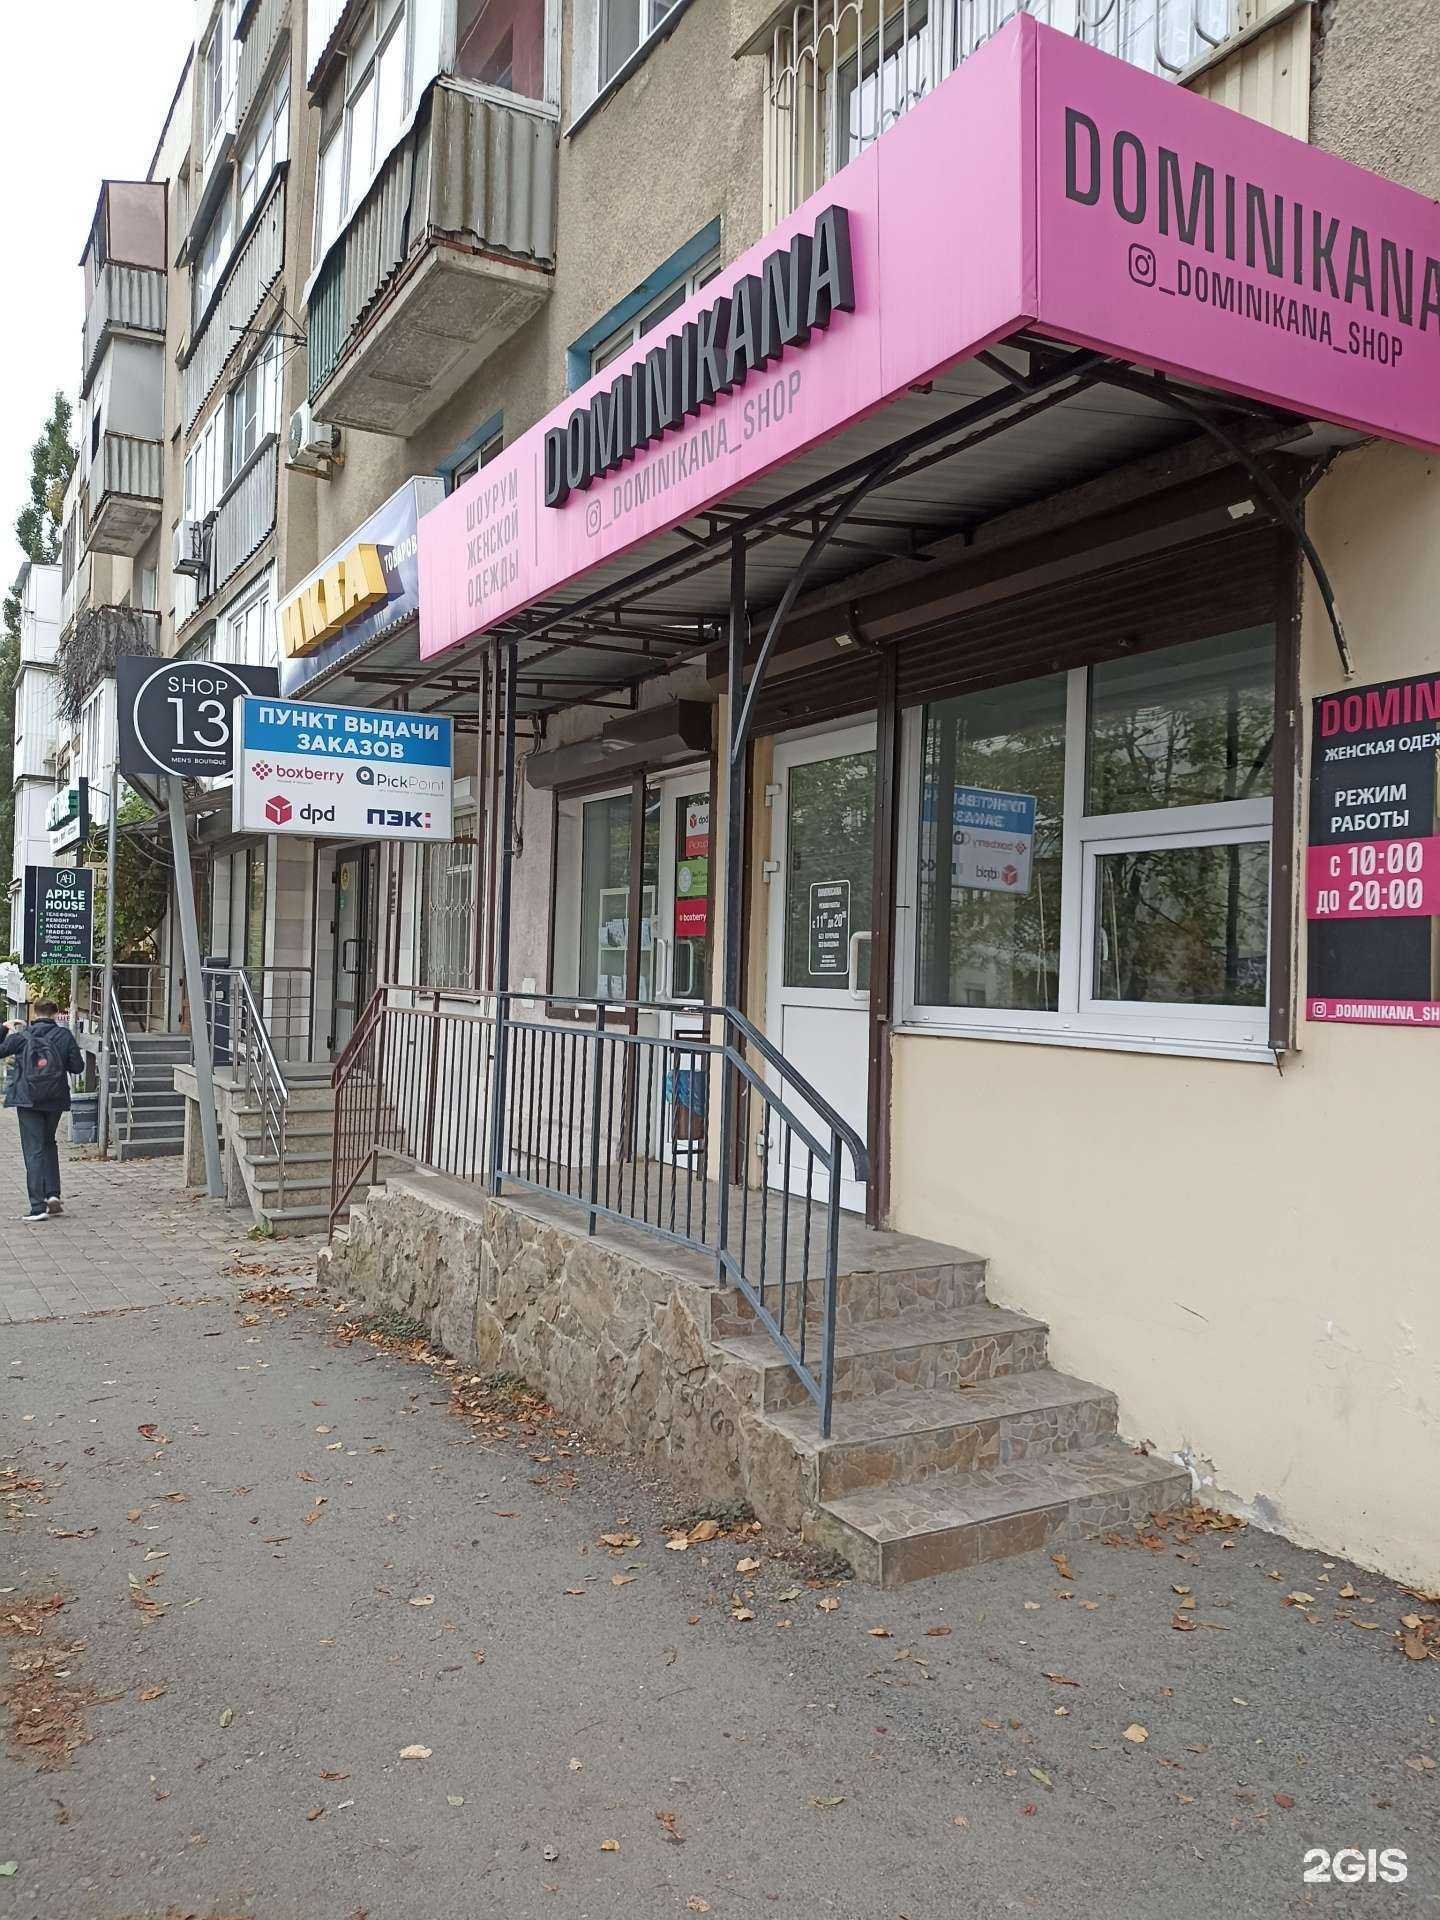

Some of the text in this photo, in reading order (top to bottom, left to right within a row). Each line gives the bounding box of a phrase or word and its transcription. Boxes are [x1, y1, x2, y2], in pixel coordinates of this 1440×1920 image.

[1065, 106, 1440, 332] DOMINIKANA
[1159, 259, 1403, 367] _DOMINIKANA_SHOP
[544, 203, 855, 508] DOMINIKANA
[602, 370, 802, 529] _DOMINIKANA_SHOP
[466, 468, 518, 532] ШОУРУМ
[467, 503, 519, 570] ЖЕНСКОЙ
[468, 550, 519, 608] ОДЕЖДЫ
[167, 676, 228, 696] SHOP
[1321, 678, 1440, 737] DOMIN
[167, 697, 230, 748] 13
[259, 707, 439, 741] ПУНКТ ВЫДАЧИ
[297, 733, 404, 759] ЗАКАЗОВ
[1324, 739, 1395, 762] ЖЕНСКАЯ
[194, 758, 226, 766] BOUTIQUE
[276, 764, 345, 784] boxberry
[377, 773, 444, 791] PickPoint
[1334, 783, 1408, 808] РЕЖИМ
[300, 803, 335, 824] dpd
[1330, 810, 1410, 833] РАБОТЫ
[1348, 841, 1424, 877] 10:00
[45, 889, 86, 900] APPLE
[45, 900, 86, 911] HOUSE
[1347, 878, 1424, 911] 20:00
[683, 913, 707, 922] boxberry
